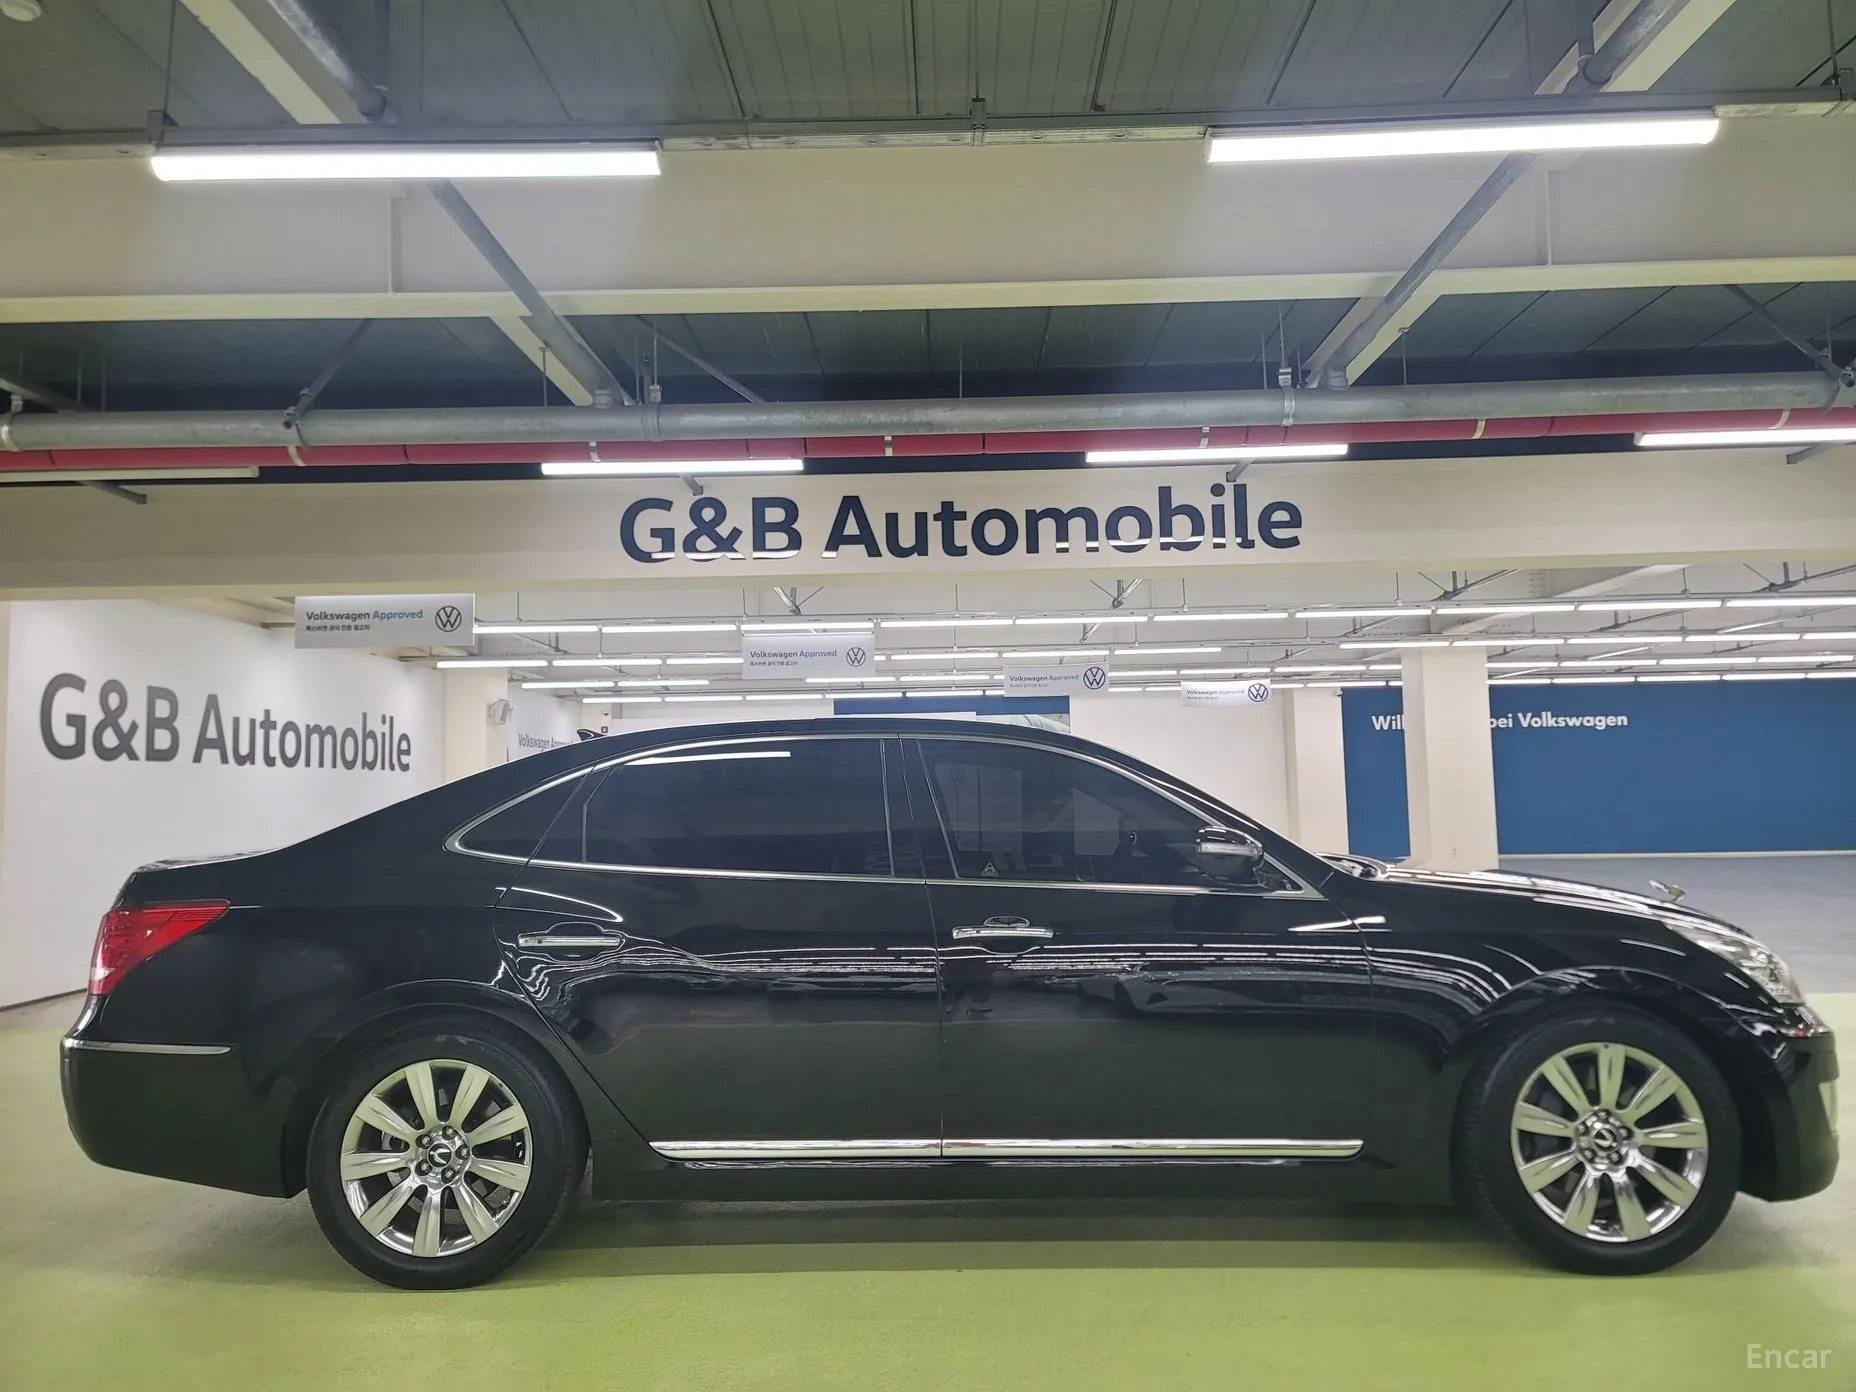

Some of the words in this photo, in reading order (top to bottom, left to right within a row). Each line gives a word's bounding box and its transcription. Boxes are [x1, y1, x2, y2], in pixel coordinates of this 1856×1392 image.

[620, 496, 803, 564] G&B
[821, 482, 1303, 559] Automobile
[305, 610, 371, 623] Volkswagen
[372, 609, 424, 622] Approved
[749, 650, 798, 660] Volkswagen
[799, 650, 838, 659] Approved
[1009, 675, 1048, 683] Volkswagen
[1049, 674, 1080, 682] Approved
[39, 672, 180, 762] G&B
[192, 693, 412, 773] Automobile
[1517, 711, 1629, 730] Volkswagen
